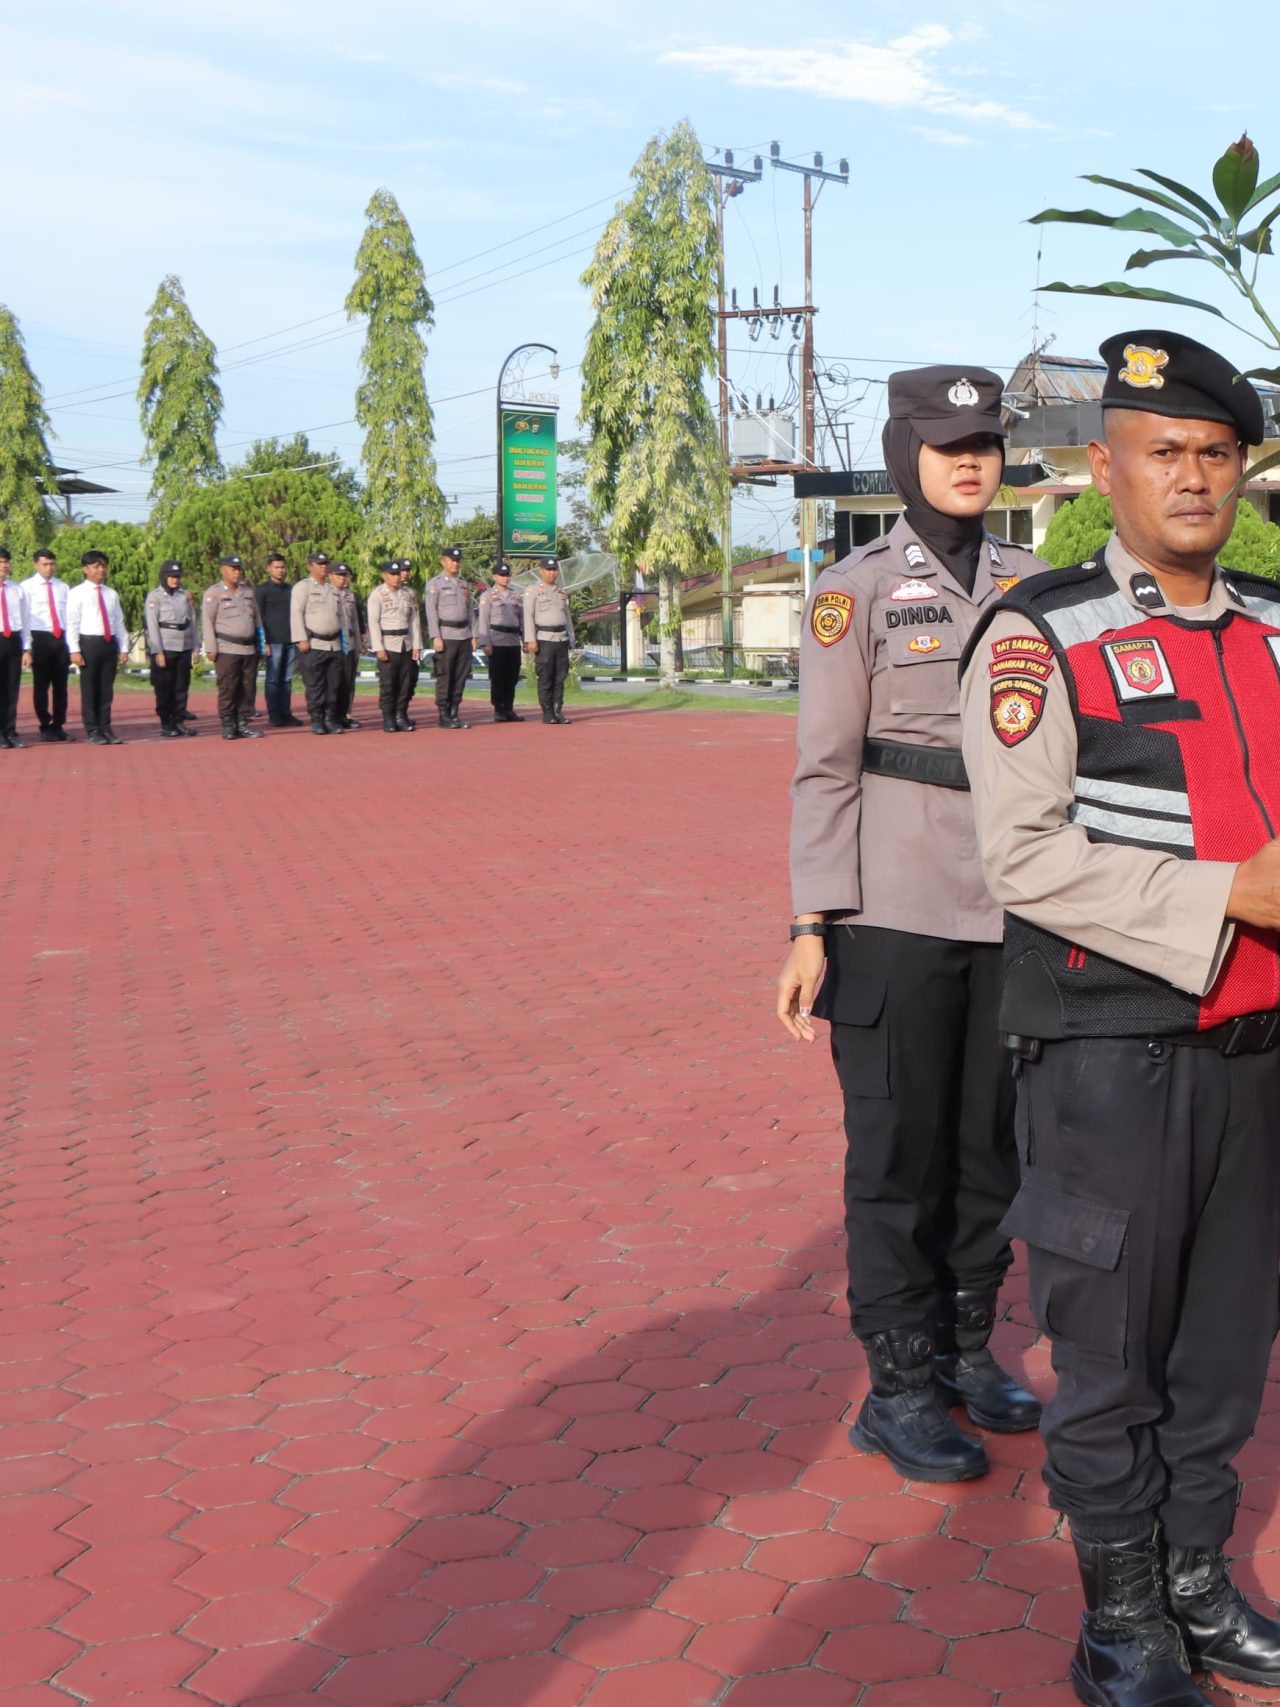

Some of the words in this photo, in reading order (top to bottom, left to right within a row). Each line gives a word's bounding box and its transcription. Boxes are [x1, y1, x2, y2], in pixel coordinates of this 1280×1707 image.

[830, 595, 849, 606] POLRI
[885, 605, 953, 629] DINDA
[996, 640, 1010, 653] SAT
[1011, 639, 1049, 655] SAMAPTA
[1112, 642, 1153, 654] SAMAPTA
[1026, 661, 1047, 675] POLRI
[1014, 680, 1044, 696] SABHARA
